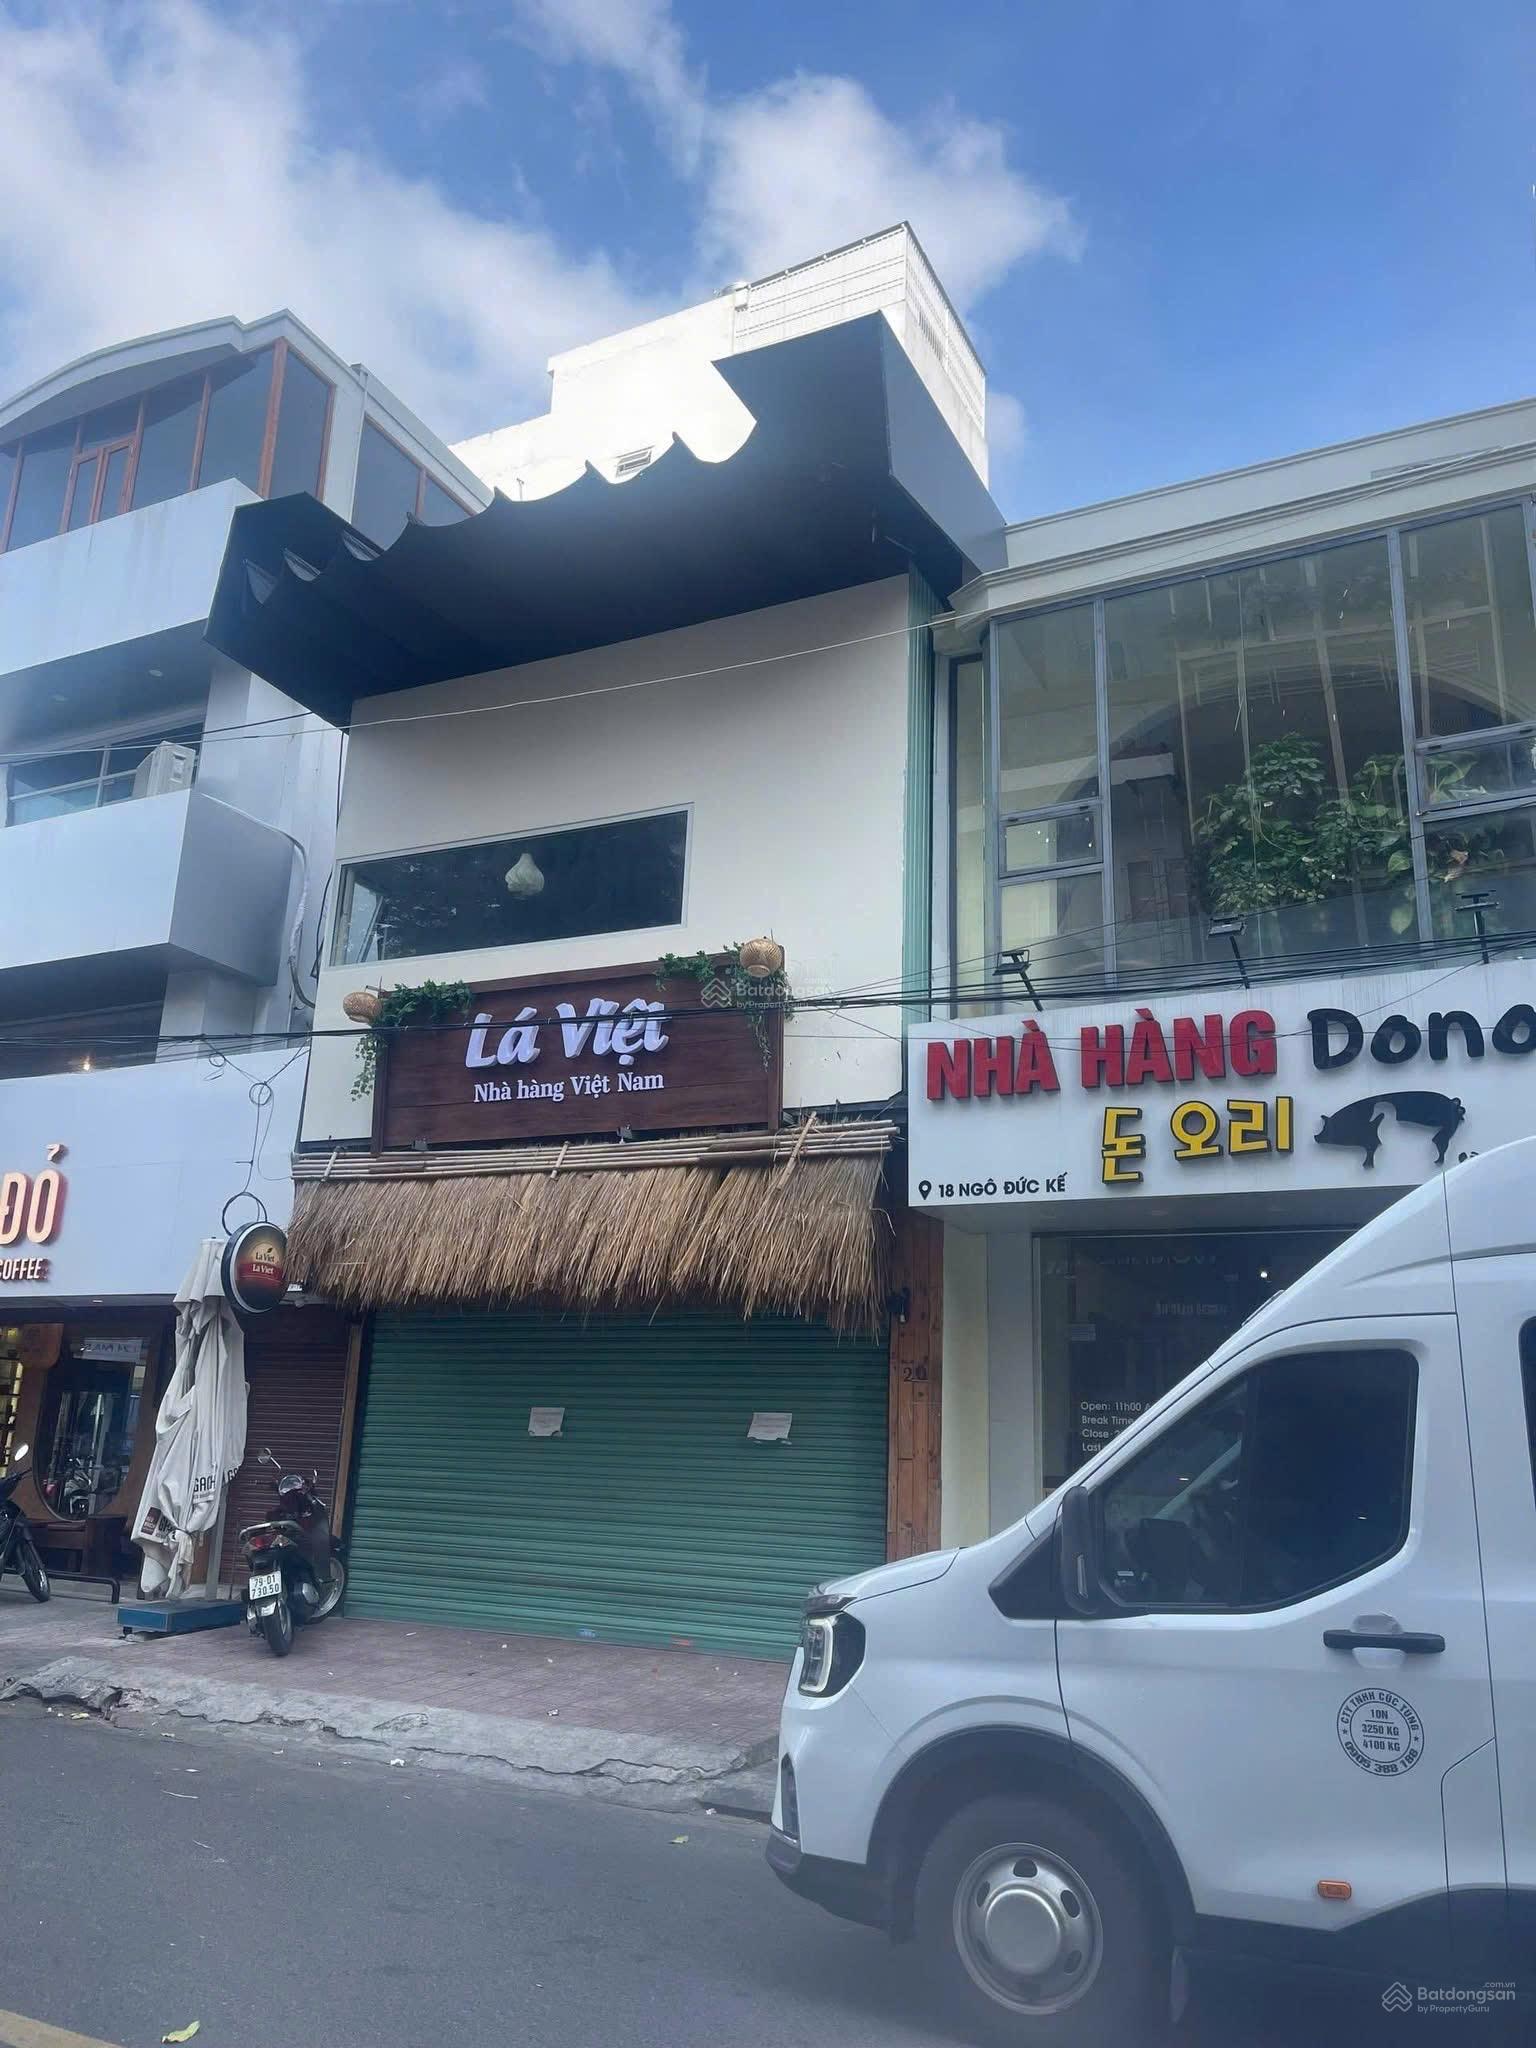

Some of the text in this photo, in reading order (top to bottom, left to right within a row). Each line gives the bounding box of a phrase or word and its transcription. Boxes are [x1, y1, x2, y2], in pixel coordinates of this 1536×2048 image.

[465, 997, 670, 1068] Lá Việt
[927, 1018, 1061, 1101] NHÀ
[1080, 1007, 1278, 1090] HÀNG
[474, 1071, 665, 1103] Nhà hàng Việt Nam
[1101, 1095, 1296, 1185] 돈 오리
[938, 1171, 1068, 1198] 18 NGÔ ĐỨC KẾ
[1081, 1415, 1109, 1425] Break
[1115, 1402, 1142, 1412] 11h00
[1340, 1705, 1353, 1725] CTY
[1349, 1691, 1376, 1708] TNHH
[1370, 1709, 1389, 1720] 10N
[1361, 1723, 1400, 1737] 3250 KG
[1362, 1739, 1401, 1752] 4100 KG
